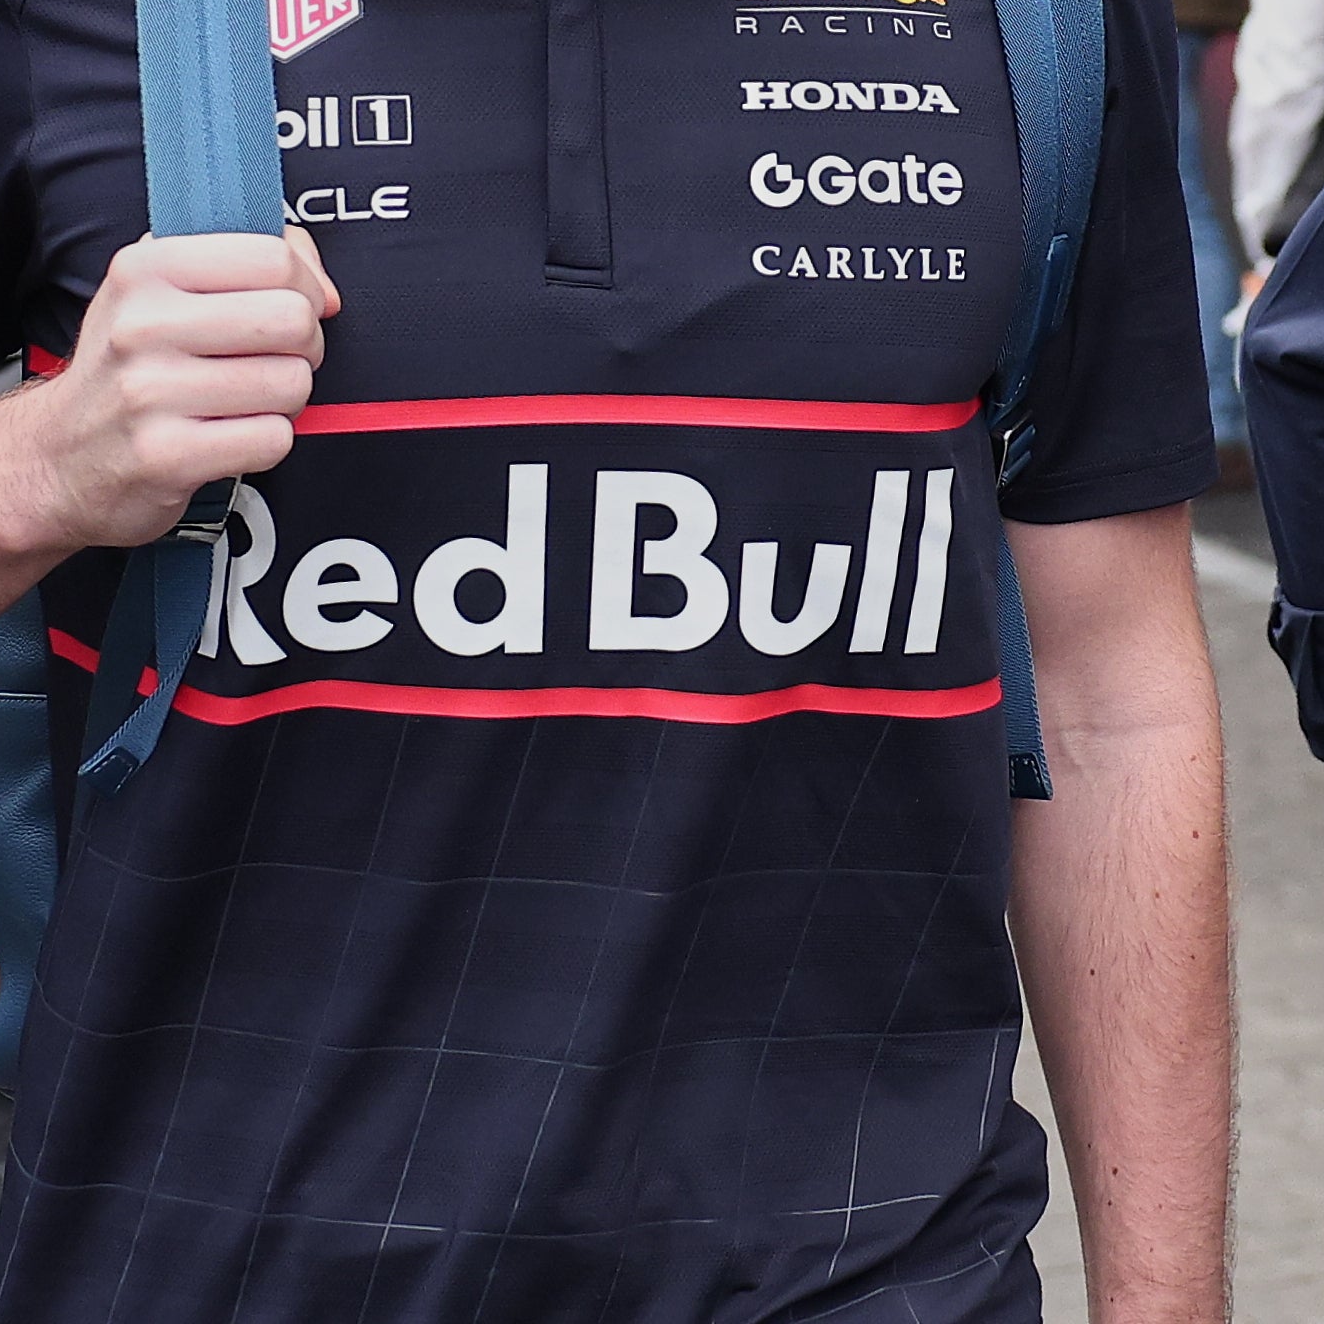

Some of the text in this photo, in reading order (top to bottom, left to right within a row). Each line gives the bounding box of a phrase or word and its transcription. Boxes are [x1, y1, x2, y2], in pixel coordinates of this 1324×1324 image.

[735, 15, 953, 40] RACING
[740, 80, 961, 114] HONDA
[275, 96, 390, 149] bil 1
[807, 154, 964, 207] Gate
[283, 185, 410, 224] CLE
[751, 244, 966, 281] CARLYLE
[197, 462, 954, 666] Red Bull
